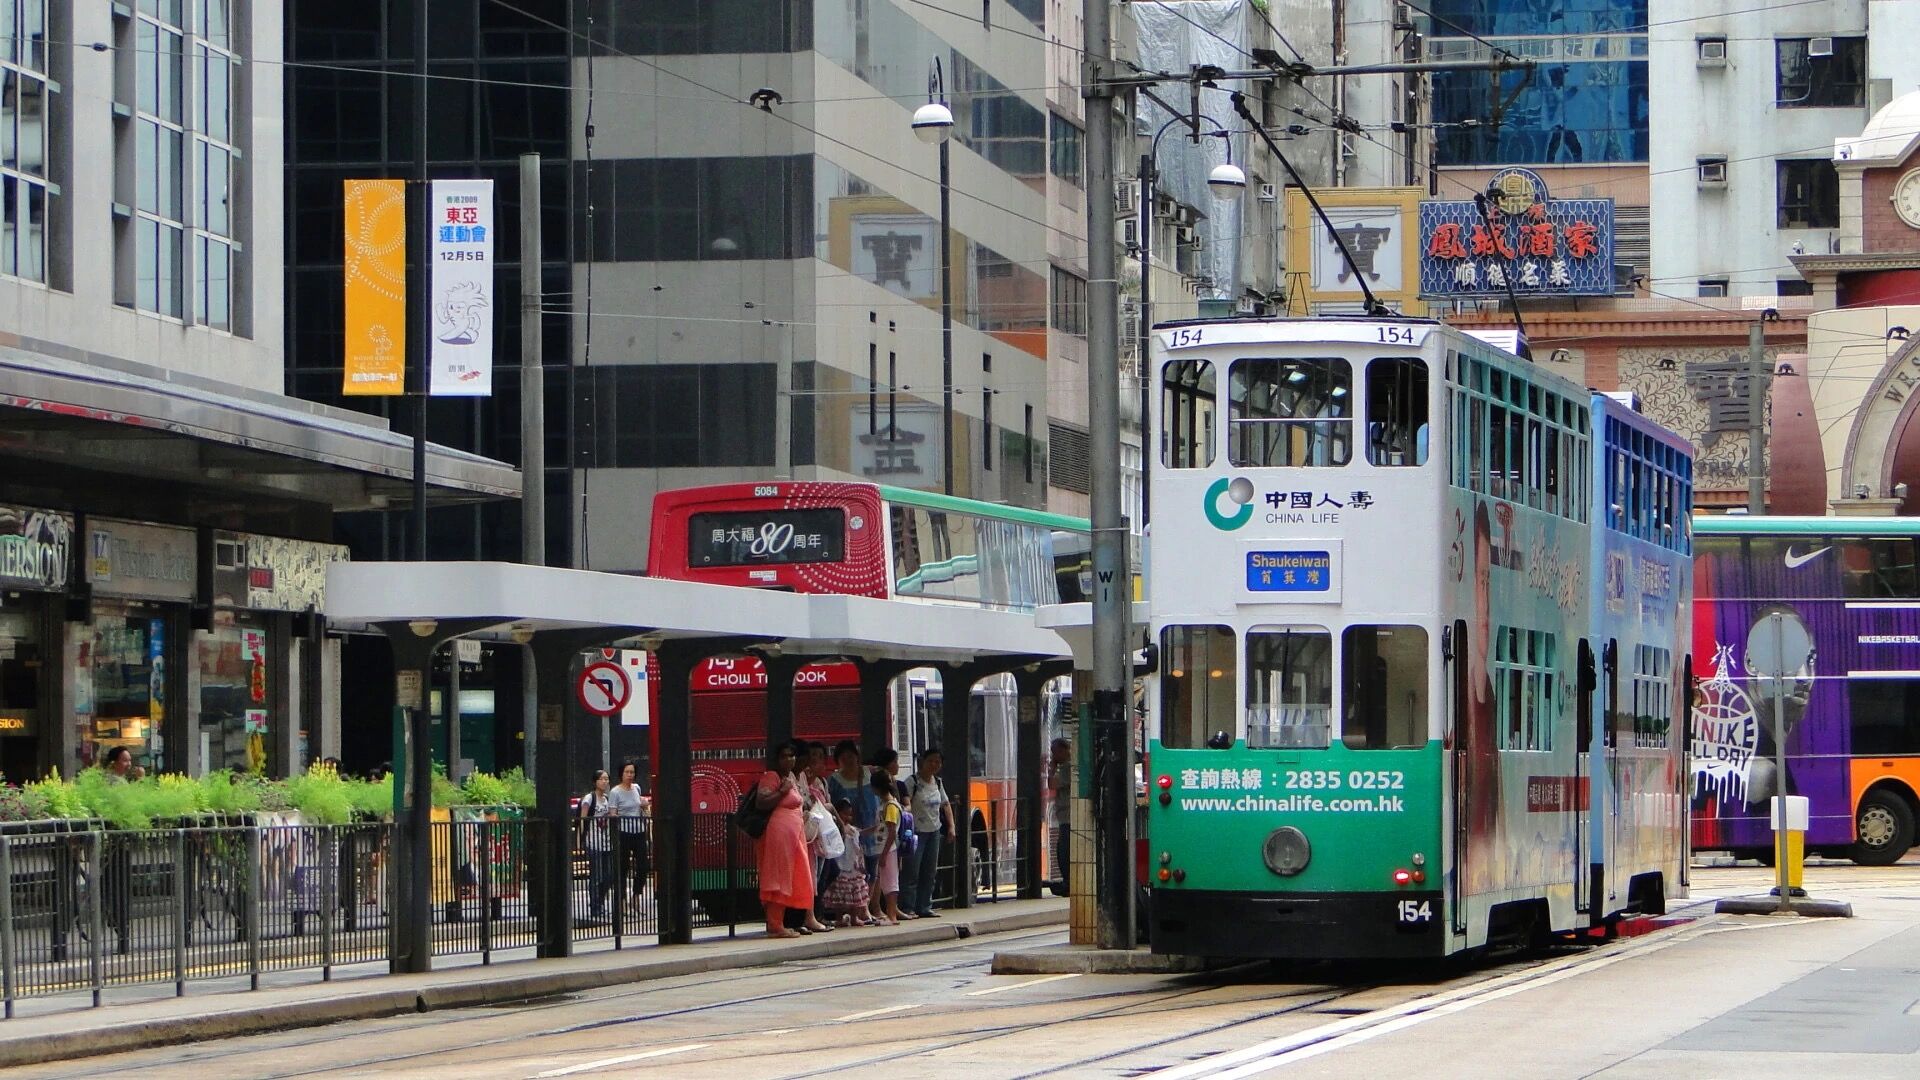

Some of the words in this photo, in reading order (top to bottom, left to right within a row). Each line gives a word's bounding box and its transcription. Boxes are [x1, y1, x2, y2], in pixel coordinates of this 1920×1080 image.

[446, 207, 478, 224] 東亞
[439, 225, 486, 243] 運動會
[1429, 220, 1599, 260] 鳳城酒家
[440, 251, 484, 262] 12月5日
[1170, 329, 1203, 348] 154
[1377, 327, 1414, 344] 154
[754, 486, 778, 497] 5084
[1265, 491, 1375, 510] 中國人壽
[1265, 513, 1305, 524] CHINA
[1311, 513, 1340, 524] LIFE
[1252, 554, 1329, 568] Shaukeiwan
[1098, 571, 1113, 583] W
[708, 673, 750, 686] CHOW
[796, 671, 827, 683] OOK
[1717, 746, 1752, 772] DAY
[1286, 771, 1341, 789] 2835
[1348, 771, 1404, 789] 0252
[1181, 795, 1404, 812] www.chinalife.com.hk
[1397, 900, 1432, 922] 154
